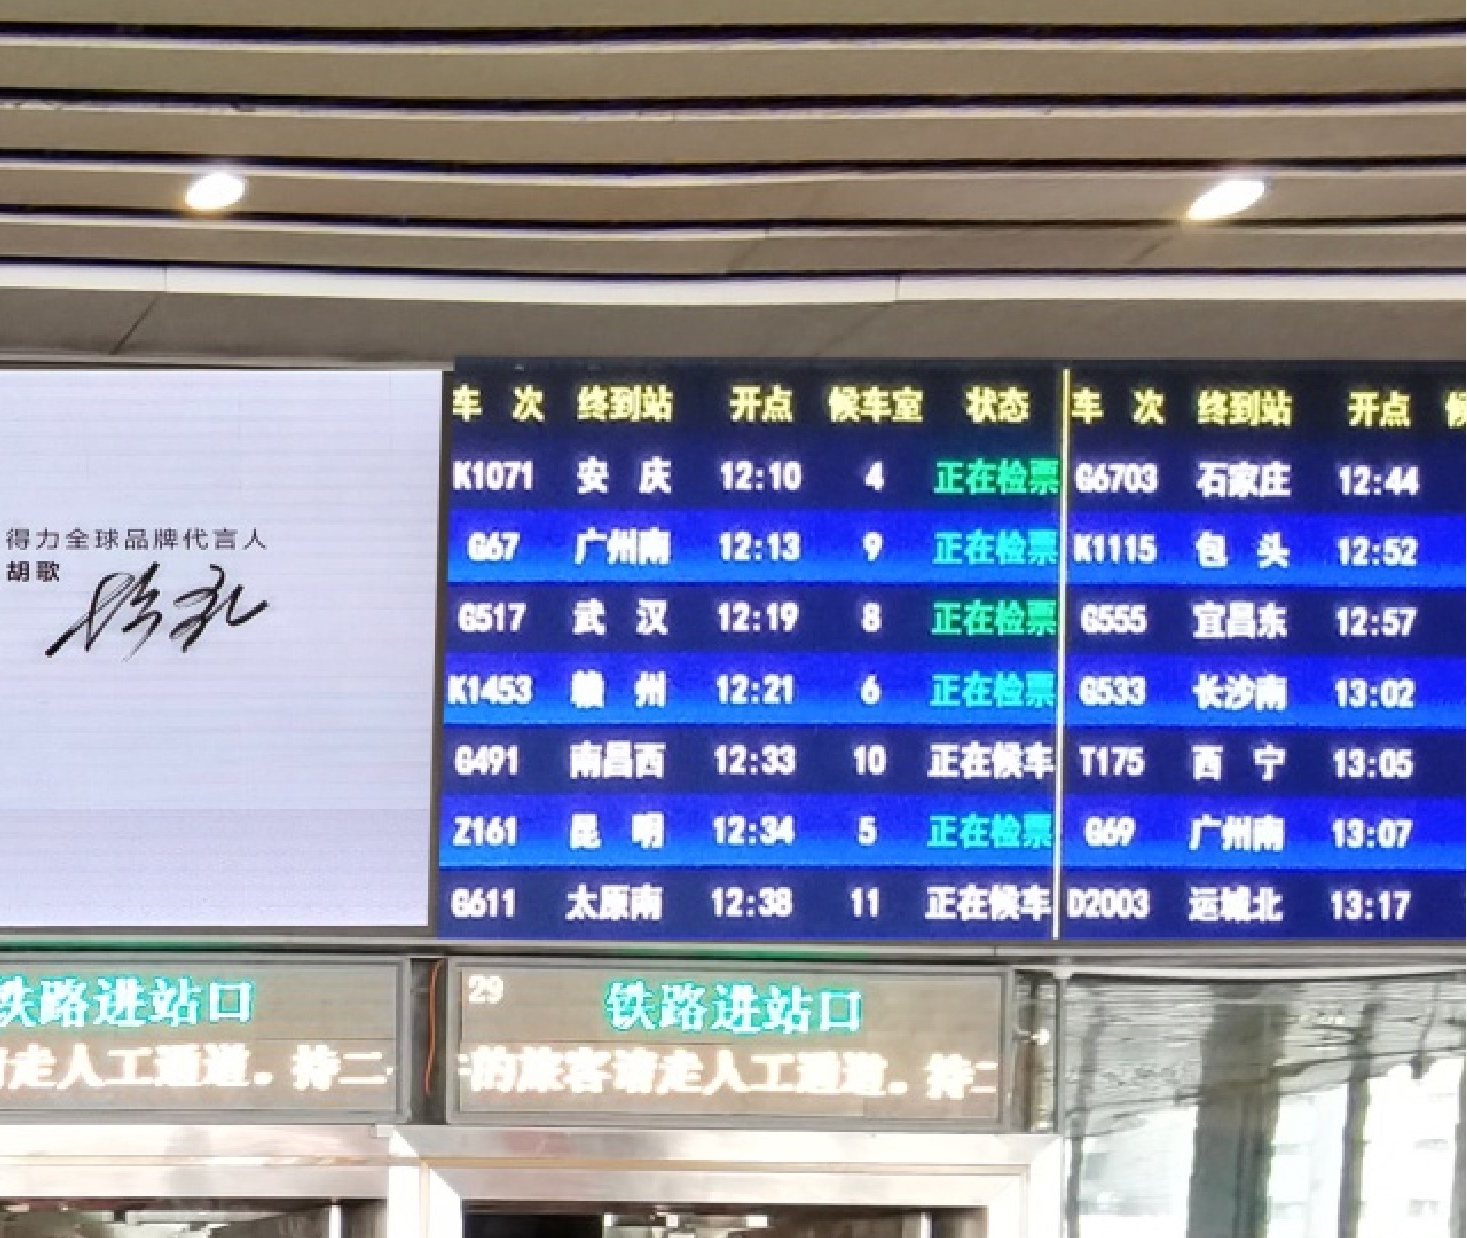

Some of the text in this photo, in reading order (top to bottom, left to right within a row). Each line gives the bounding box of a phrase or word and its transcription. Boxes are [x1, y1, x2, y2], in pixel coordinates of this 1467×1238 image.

[579, 385, 674, 422] 终到站
[731, 385, 793, 422] 开点
[830, 385, 924, 422] 候车室
[967, 386, 1029, 423] 状态
[1199, 390, 1293, 426] 终到站
[1350, 391, 1410, 427] 开点
[454, 461, 532, 490] K1071
[722, 461, 802, 490] 12:10
[866, 461, 885, 490] 4
[935, 457, 1058, 494] 正在检票
[1075, 461, 1419, 497] G6703 石家庄 12:44
[5, 528, 267, 550] 得力全球品牌代言人
[469, 527, 1057, 567] G67 广州南 12:13 9 正在检票
[1073, 534, 1158, 564] K1115
[1339, 536, 1419, 566] 12:52
[6, 560, 60, 582] 胡歌
[459, 603, 527, 632] G517
[719, 603, 800, 632] 12:19
[863, 603, 882, 632] 8
[933, 599, 1056, 636] 正在检票
[1081, 600, 1417, 639] G555 宜昌东 12:57
[449, 675, 532, 704] K1453
[718, 675, 794, 704] 12:21
[862, 675, 880, 704] 6
[931, 672, 1055, 709] 正在检票
[1080, 674, 1414, 710] G533 长沙南 13:02
[455, 740, 1054, 780] G491 南昌西 12:33 10 正在候车
[1080, 747, 1146, 776] T175
[1335, 749, 1414, 777] 13:05
[454, 816, 516, 846] Z161
[714, 816, 796, 846] 12:34
[859, 816, 878, 846] 5
[928, 813, 1053, 851] 正在检票
[1086, 814, 1412, 852] G69 广州南 13:07
[452, 883, 1052, 922] G611 太原南 12:38 11 正在候车
[1069, 885, 1412, 921] D2003 运城北 13:17
[468, 974, 504, 1004] 29
[605, 982, 862, 1034] 铁路进站口
